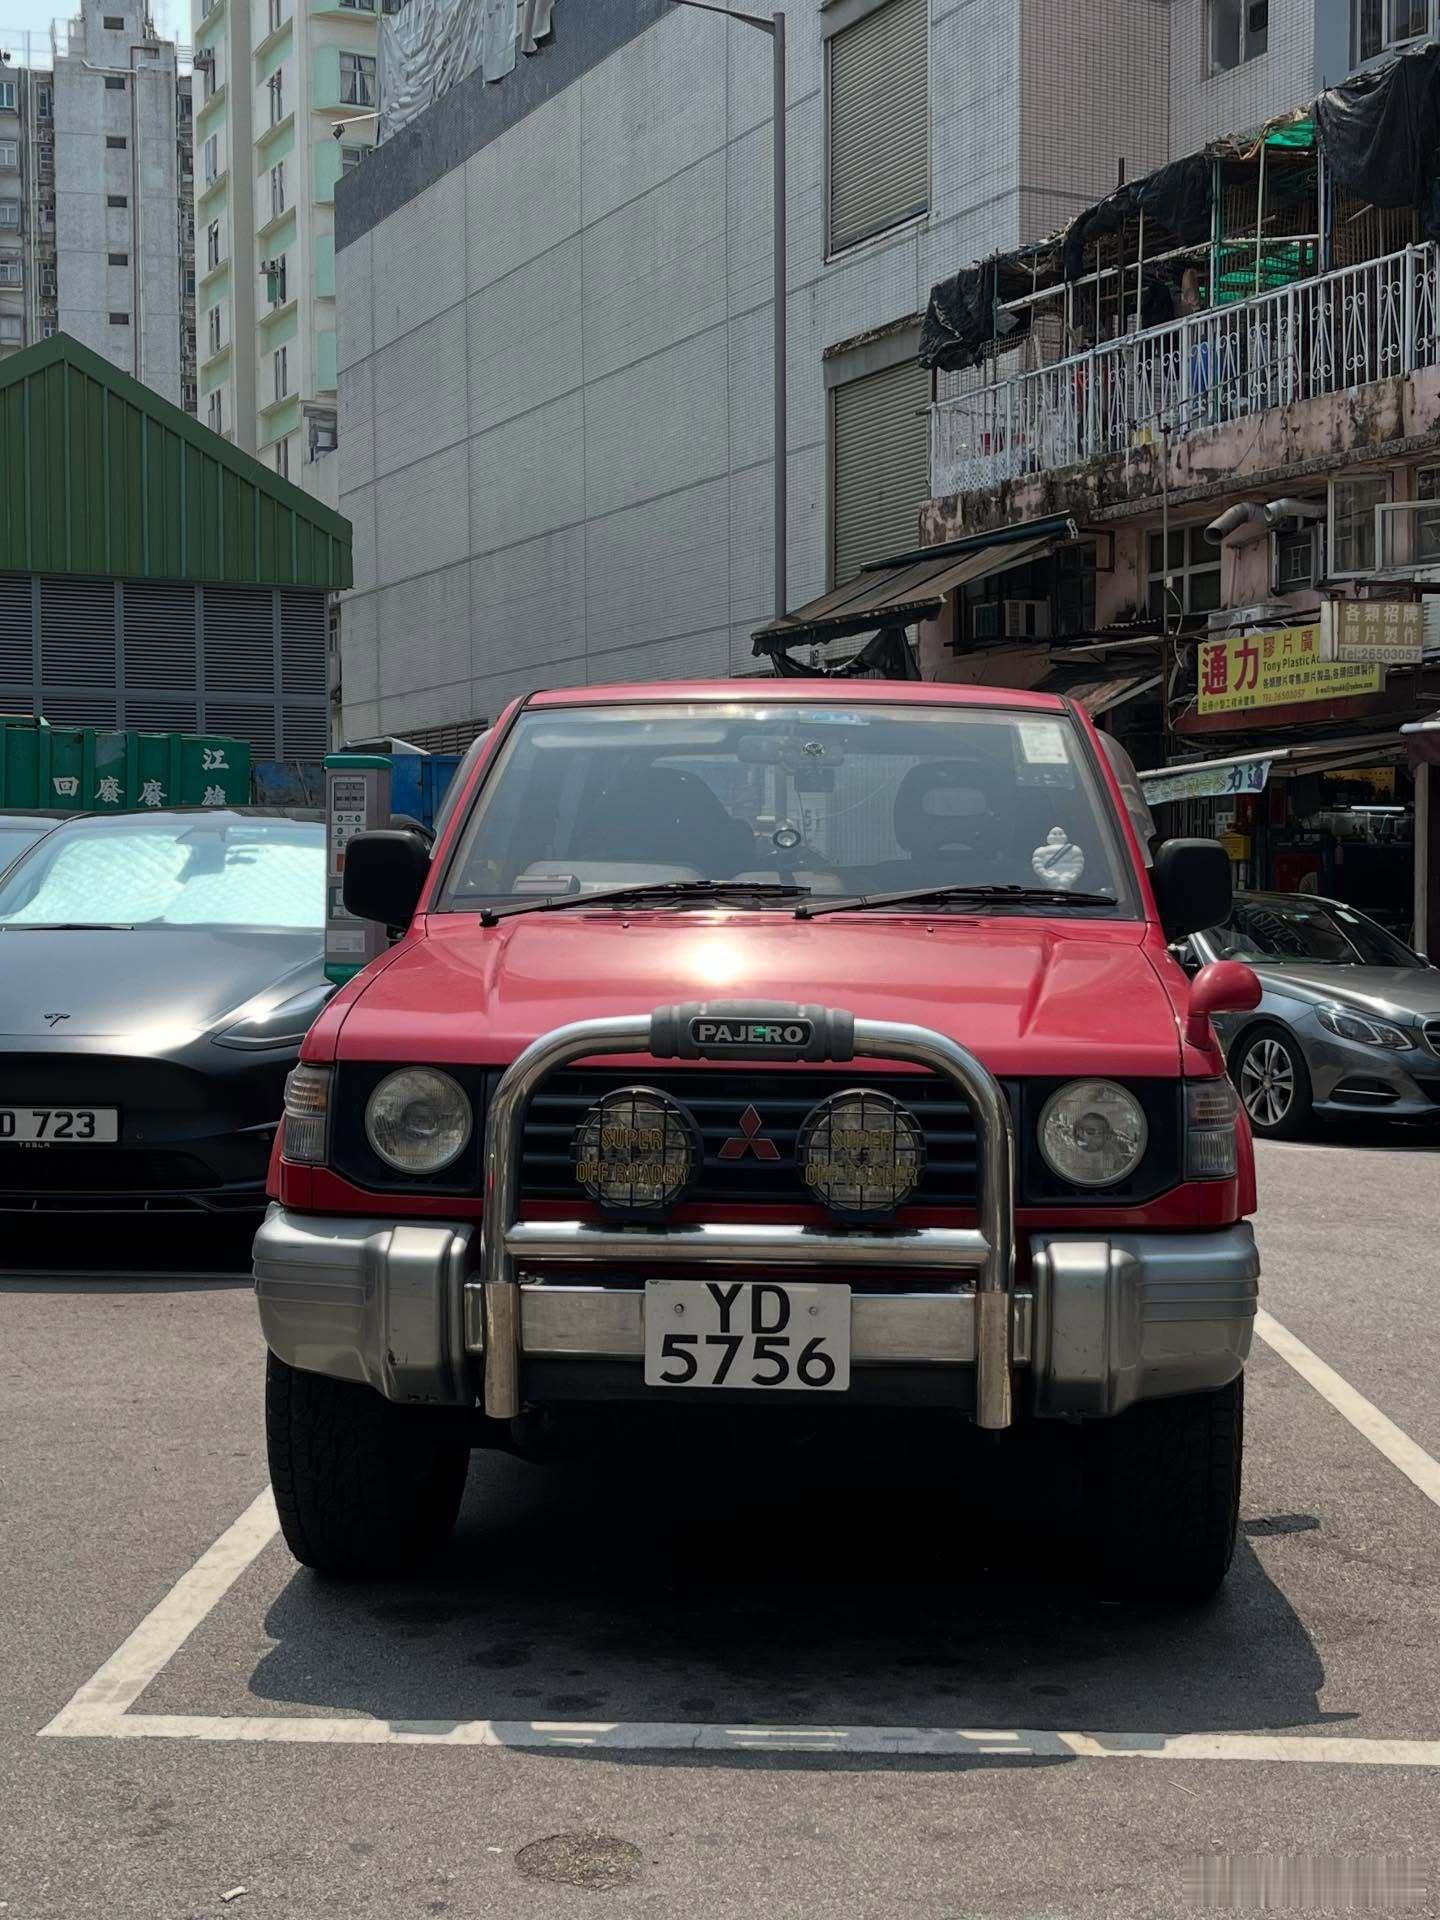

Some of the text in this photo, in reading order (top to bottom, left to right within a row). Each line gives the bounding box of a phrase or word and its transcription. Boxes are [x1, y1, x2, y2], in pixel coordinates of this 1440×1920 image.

[1345, 603, 1418, 623] 各類招牌
[1344, 624, 1417, 644] 膠片製作
[1202, 639, 1259, 696] 通力
[1263, 661, 1281, 673] Tony
[1282, 656, 1309, 669] Plastic
[699, 1024, 803, 1042] PAJERO
[33, 1111, 95, 1138] 723
[601, 1128, 663, 1150] SUPER
[830, 1129, 895, 1152] SUPER
[576, 1161, 689, 1185] OFF ROADER
[705, 1283, 791, 1334] YD
[660, 1334, 835, 1387] 5756
